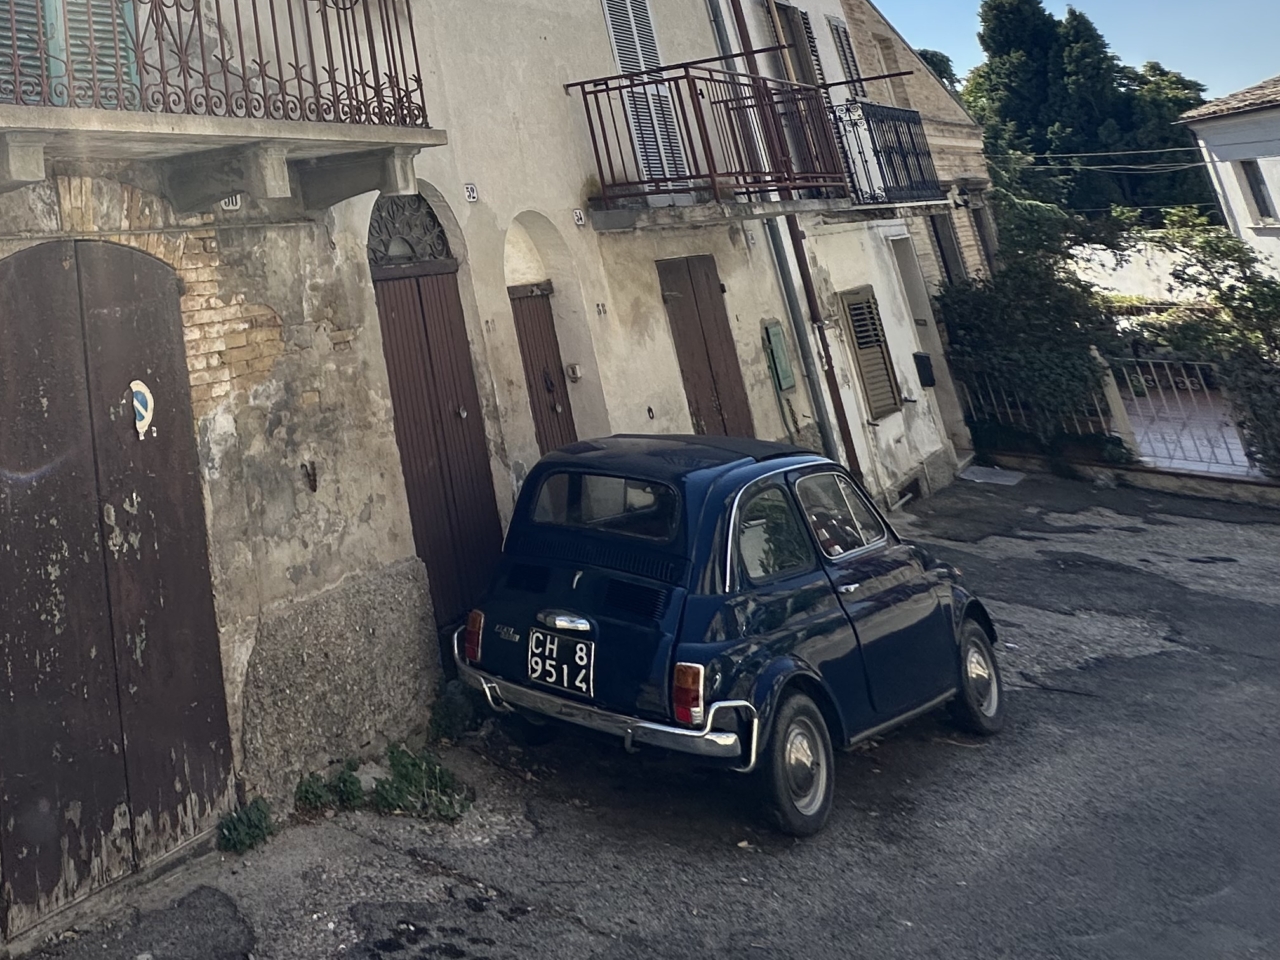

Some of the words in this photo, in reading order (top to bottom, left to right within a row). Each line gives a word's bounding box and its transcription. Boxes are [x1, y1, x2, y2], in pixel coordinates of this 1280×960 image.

[465, 186, 476, 200] 52
[531, 632, 558, 658] CH
[575, 643, 588, 666] 8
[531, 657, 587, 692] 9514
